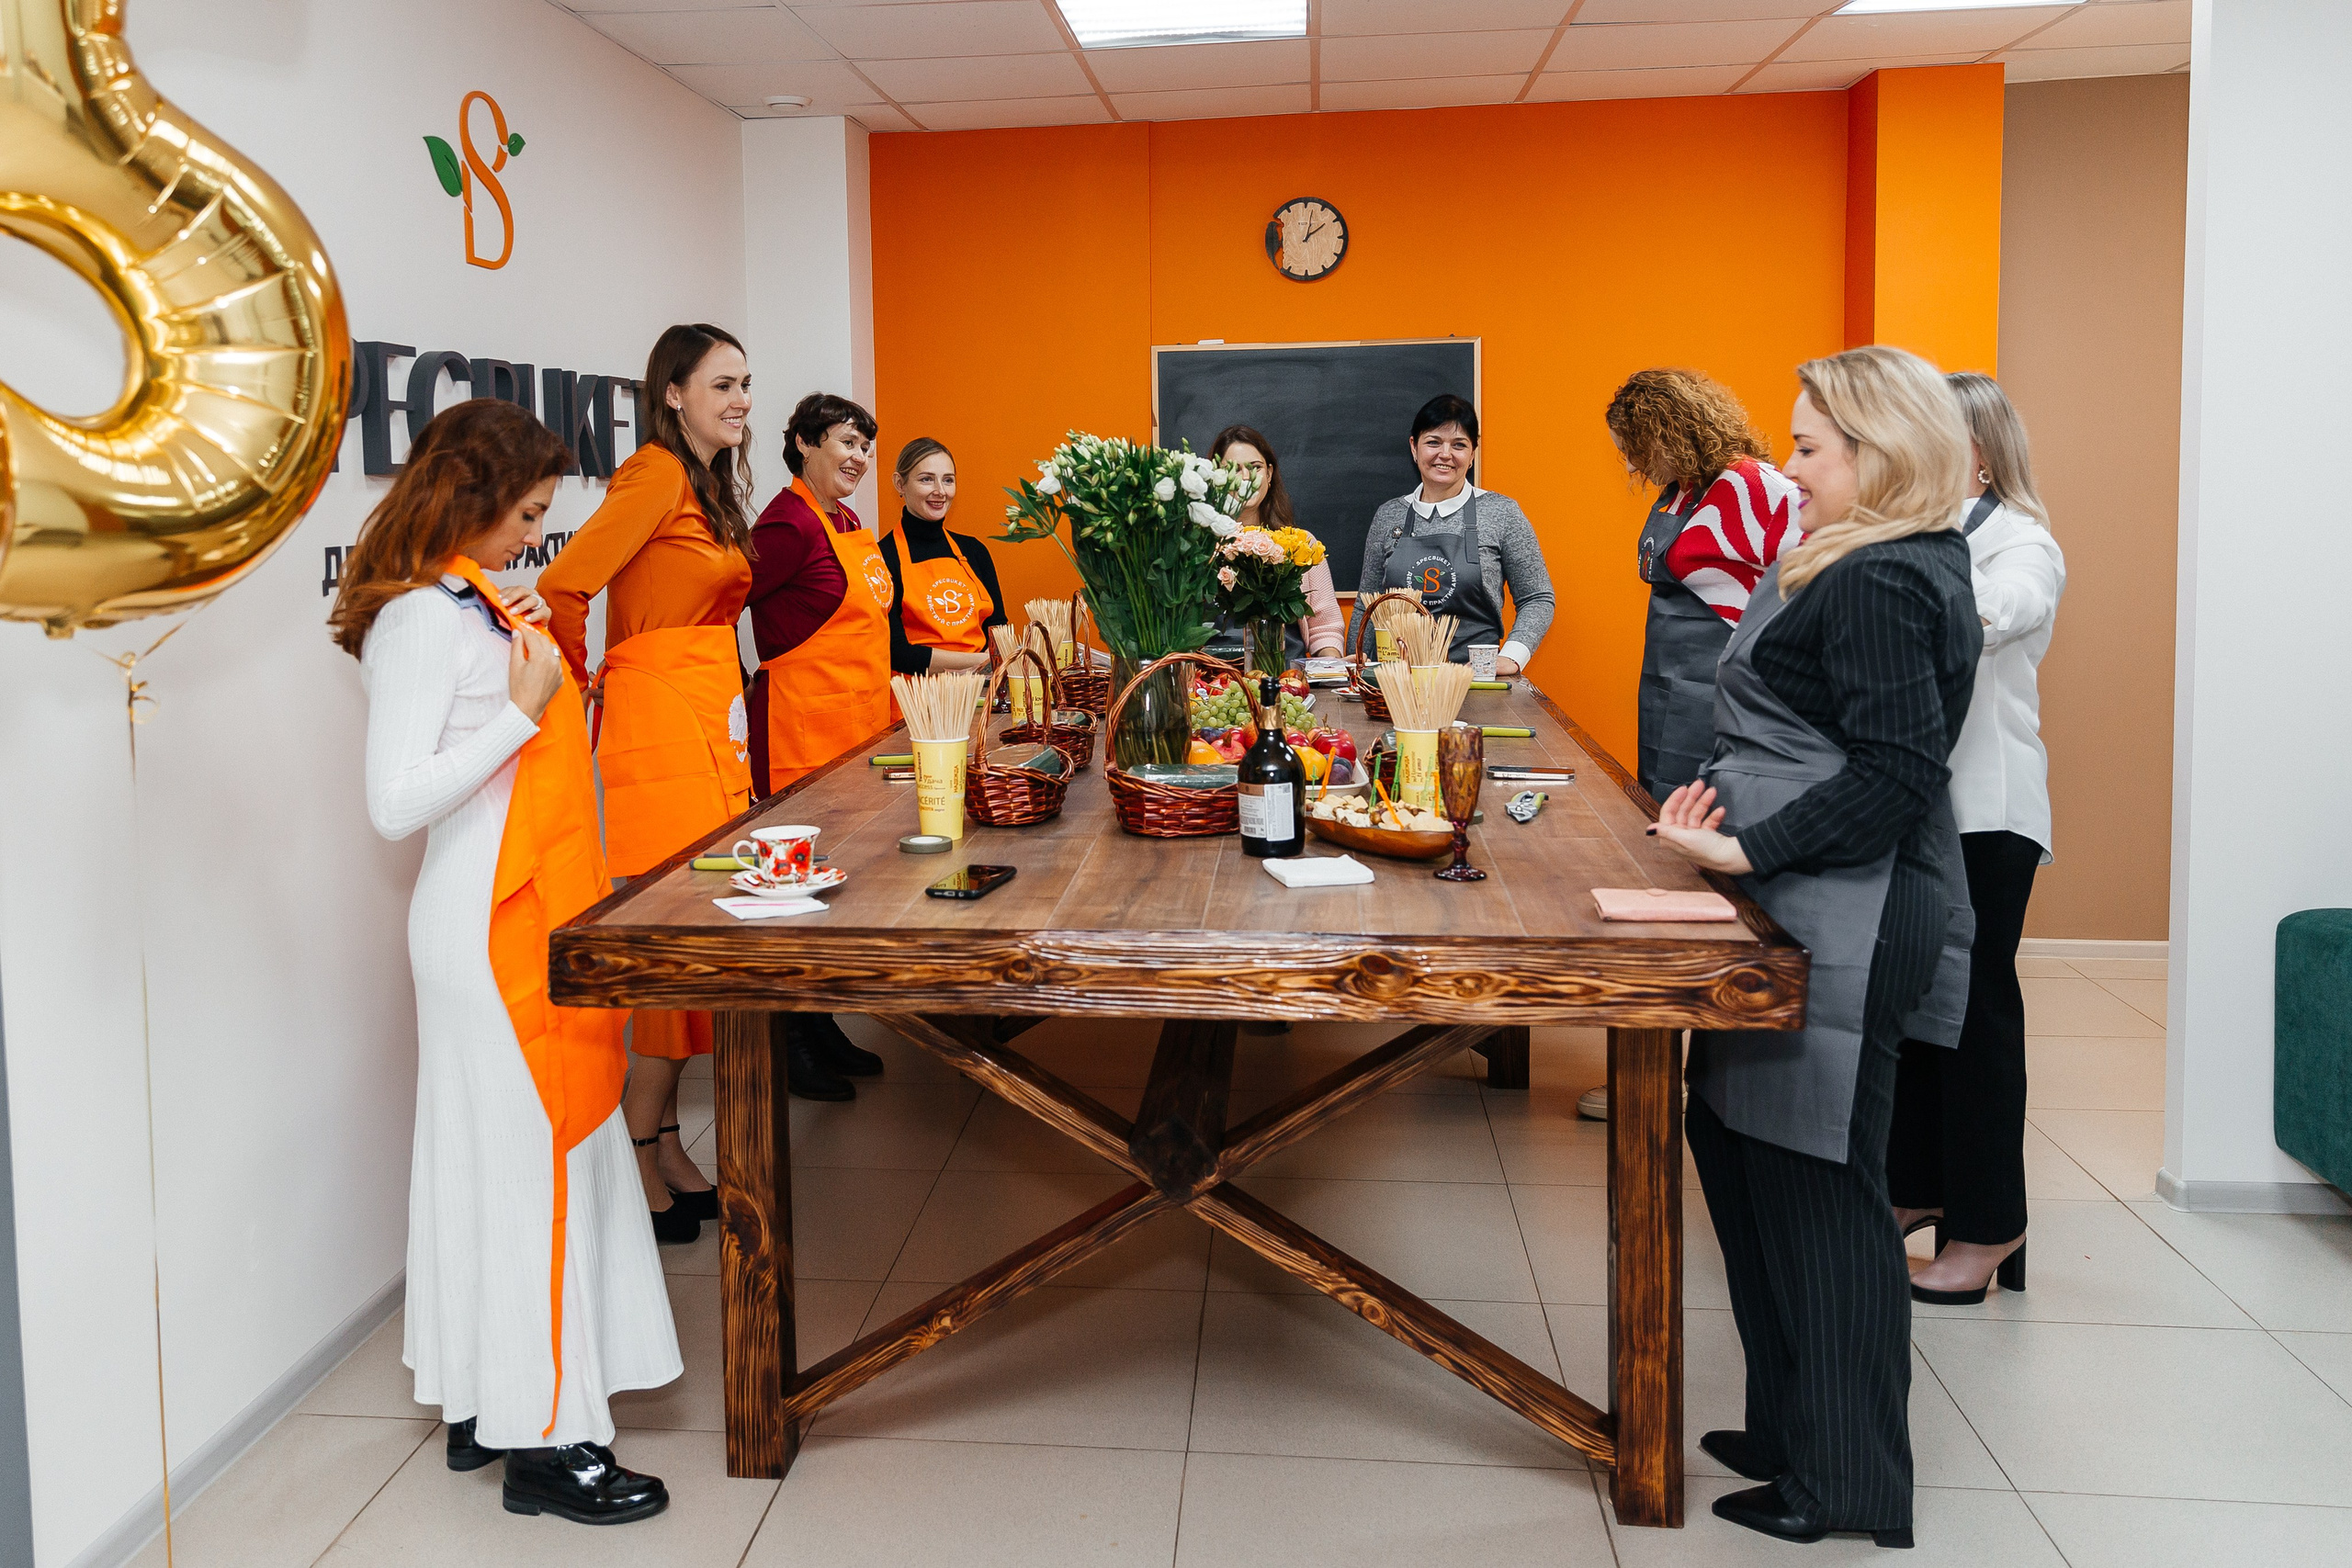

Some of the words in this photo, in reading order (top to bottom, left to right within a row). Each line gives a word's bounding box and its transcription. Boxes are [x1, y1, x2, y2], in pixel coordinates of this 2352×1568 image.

[1416, 555, 1452, 567] SPECBUKET
[932, 578, 967, 589] SPECBUKET
[920, 795, 945, 806] CÉRITÉ
